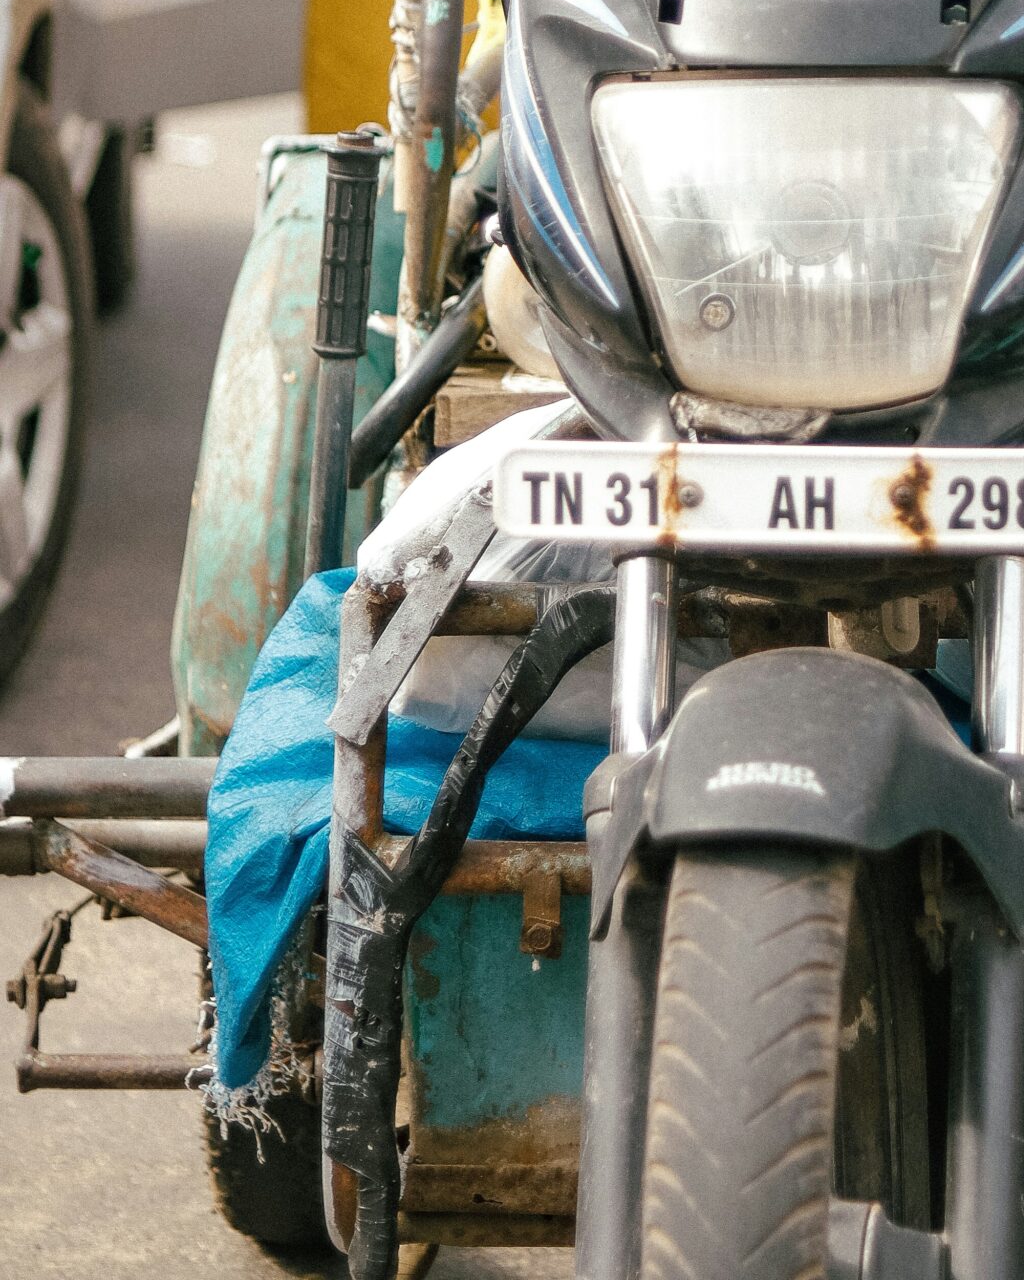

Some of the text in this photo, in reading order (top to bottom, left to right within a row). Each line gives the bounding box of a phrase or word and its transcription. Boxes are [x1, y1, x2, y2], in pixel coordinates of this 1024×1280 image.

[522, 472, 583, 525] TN
[606, 472, 659, 526] 31
[768, 476, 834, 530] AH
[705, 772, 826, 797] HONDA
